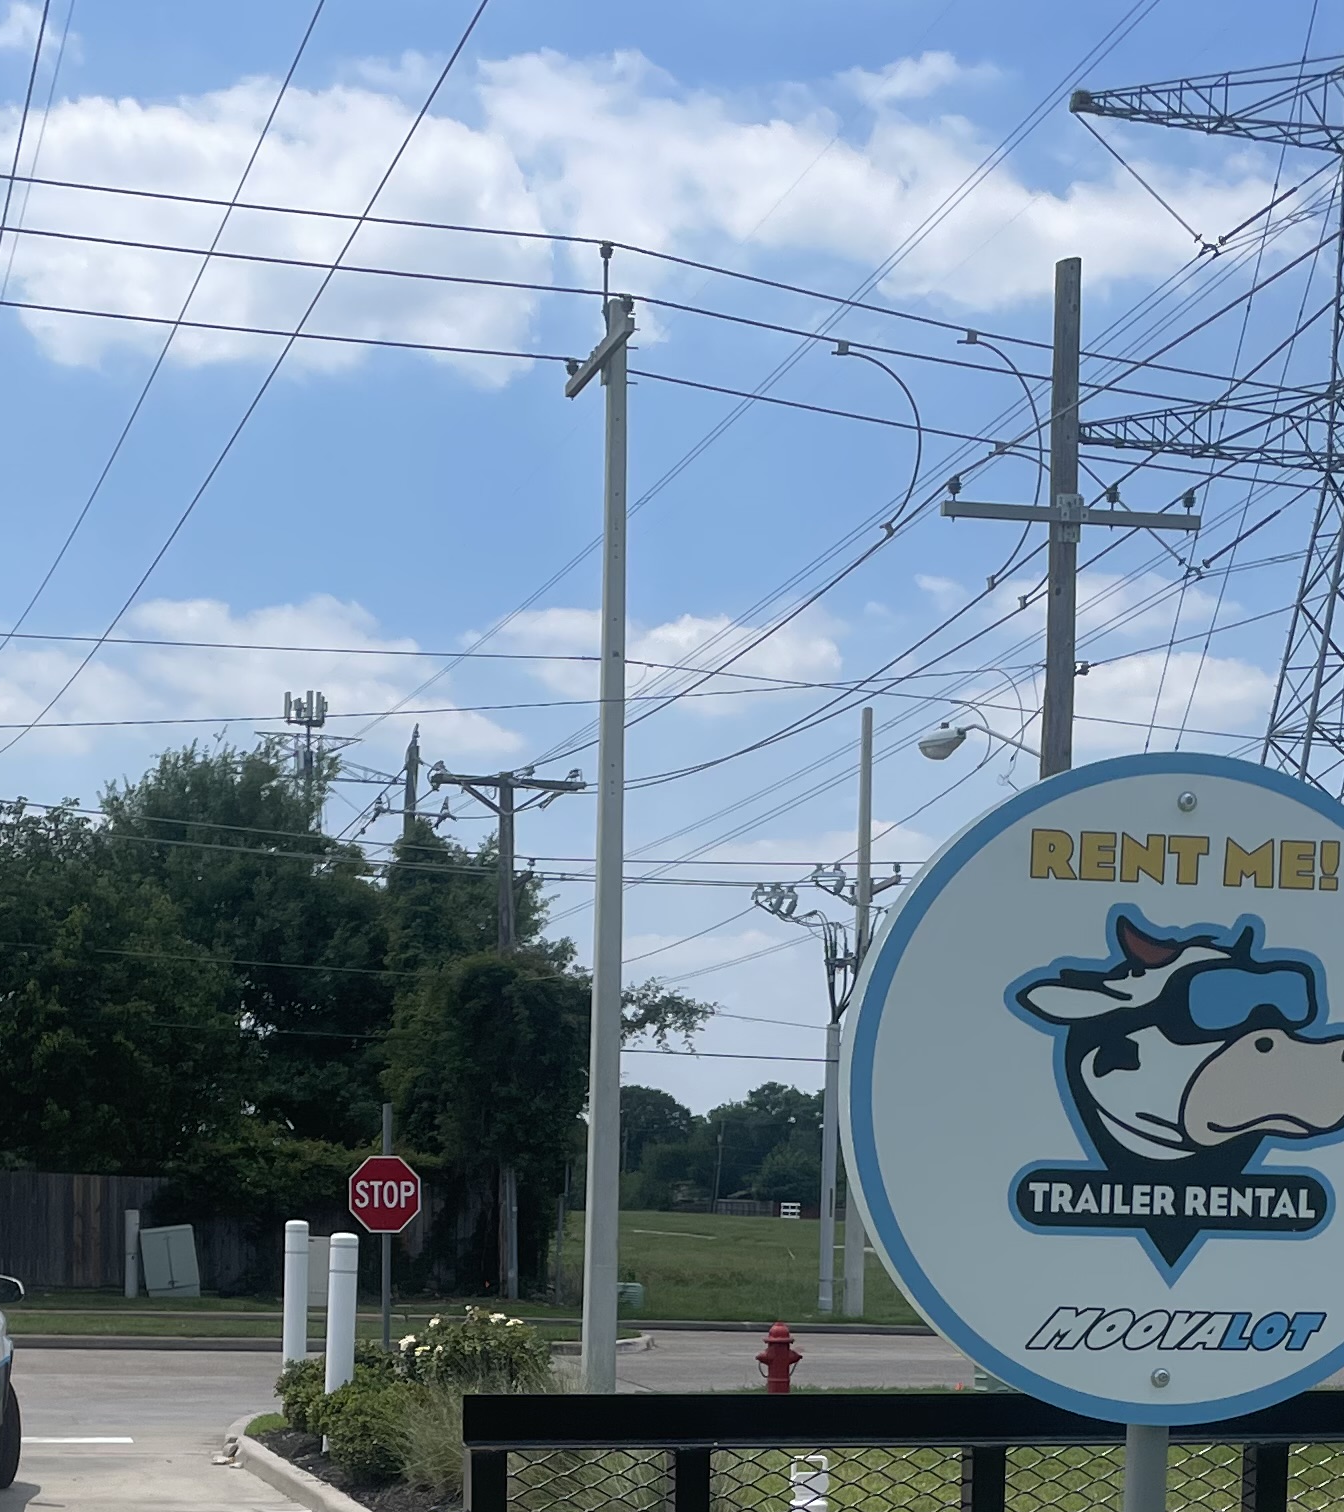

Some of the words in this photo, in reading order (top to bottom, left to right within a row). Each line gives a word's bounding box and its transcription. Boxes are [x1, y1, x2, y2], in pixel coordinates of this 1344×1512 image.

[1030, 828, 1210, 885] RENT
[1223, 836, 1340, 891] ME!
[354, 1180, 415, 1208] STOP
[1029, 1182, 1176, 1216] TRAILER
[1184, 1186, 1316, 1219] RENTAL
[1025, 1306, 1327, 1350] MOOVALOT
